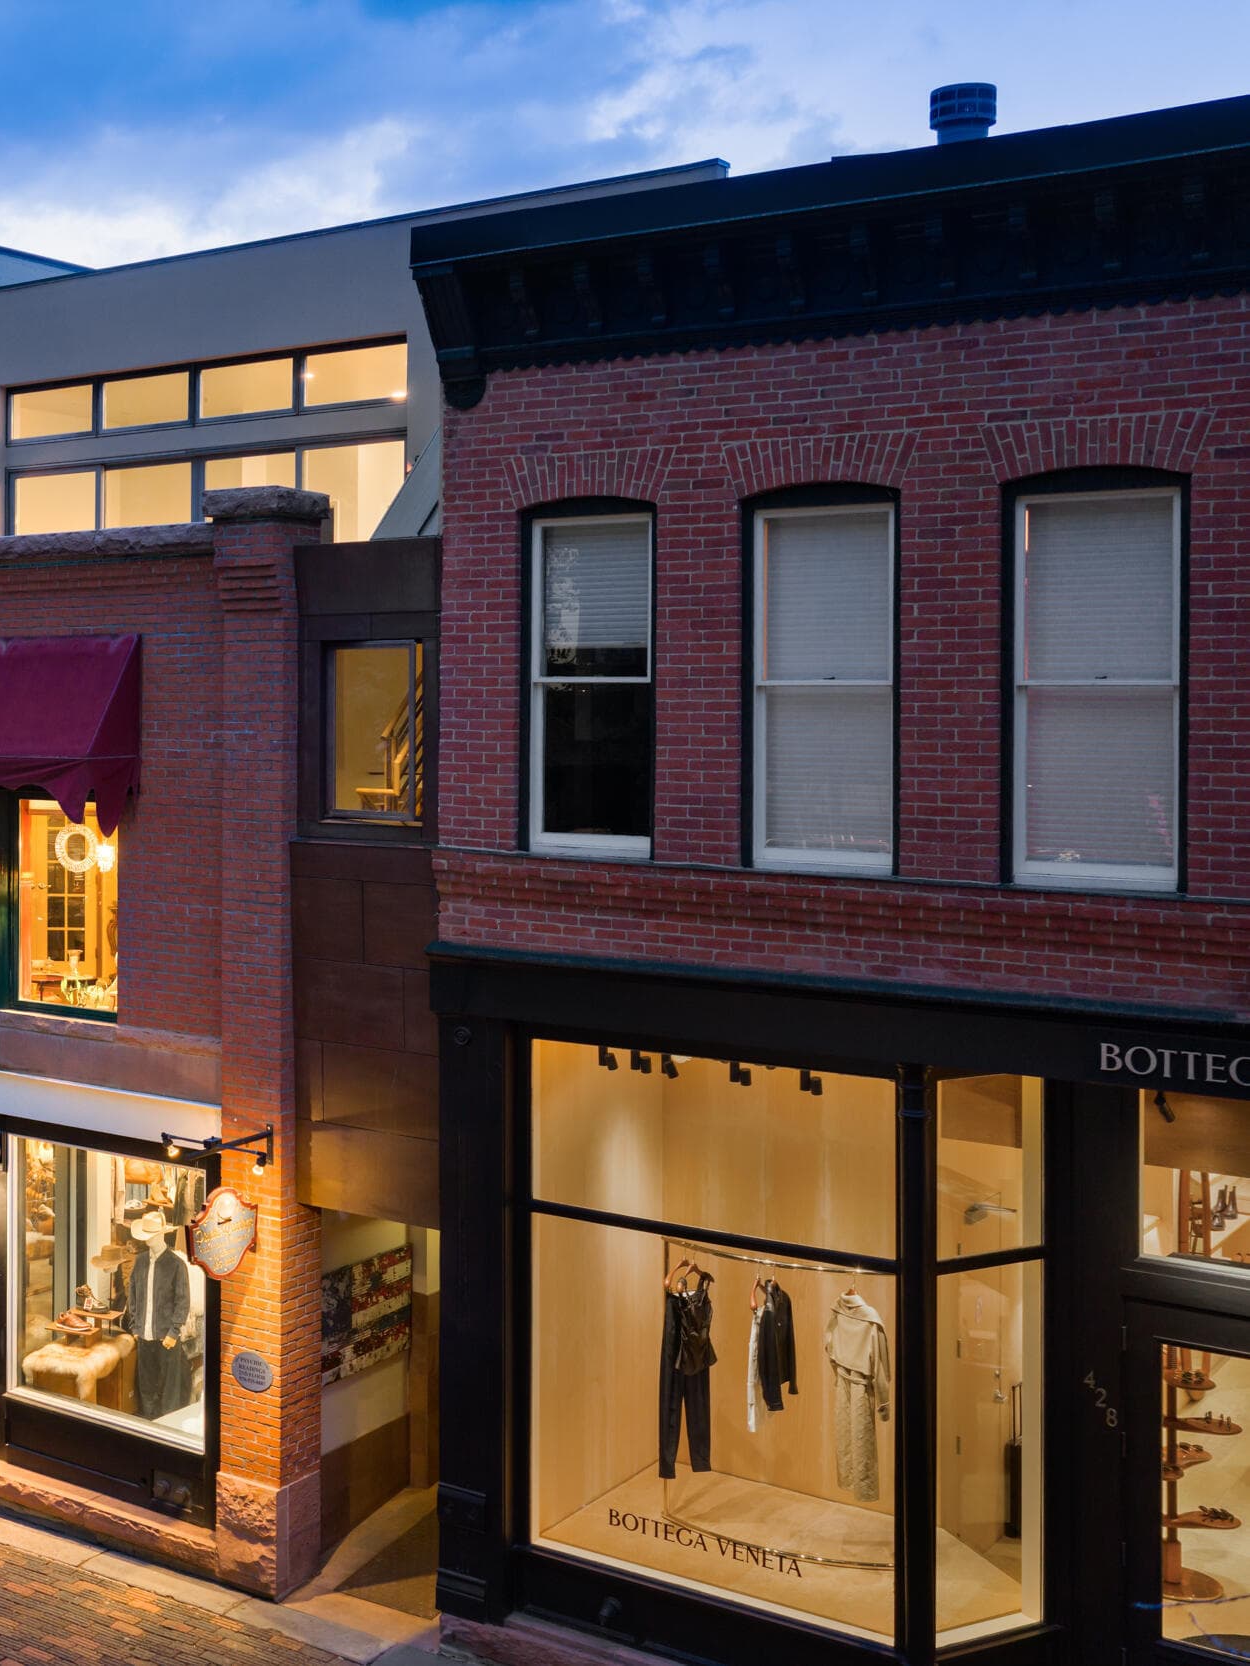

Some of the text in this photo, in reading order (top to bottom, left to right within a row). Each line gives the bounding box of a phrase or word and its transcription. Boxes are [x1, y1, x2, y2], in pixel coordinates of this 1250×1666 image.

[1083, 1370, 1118, 1427] 428
[607, 1508, 803, 1578] BOTTEGA VENETA
